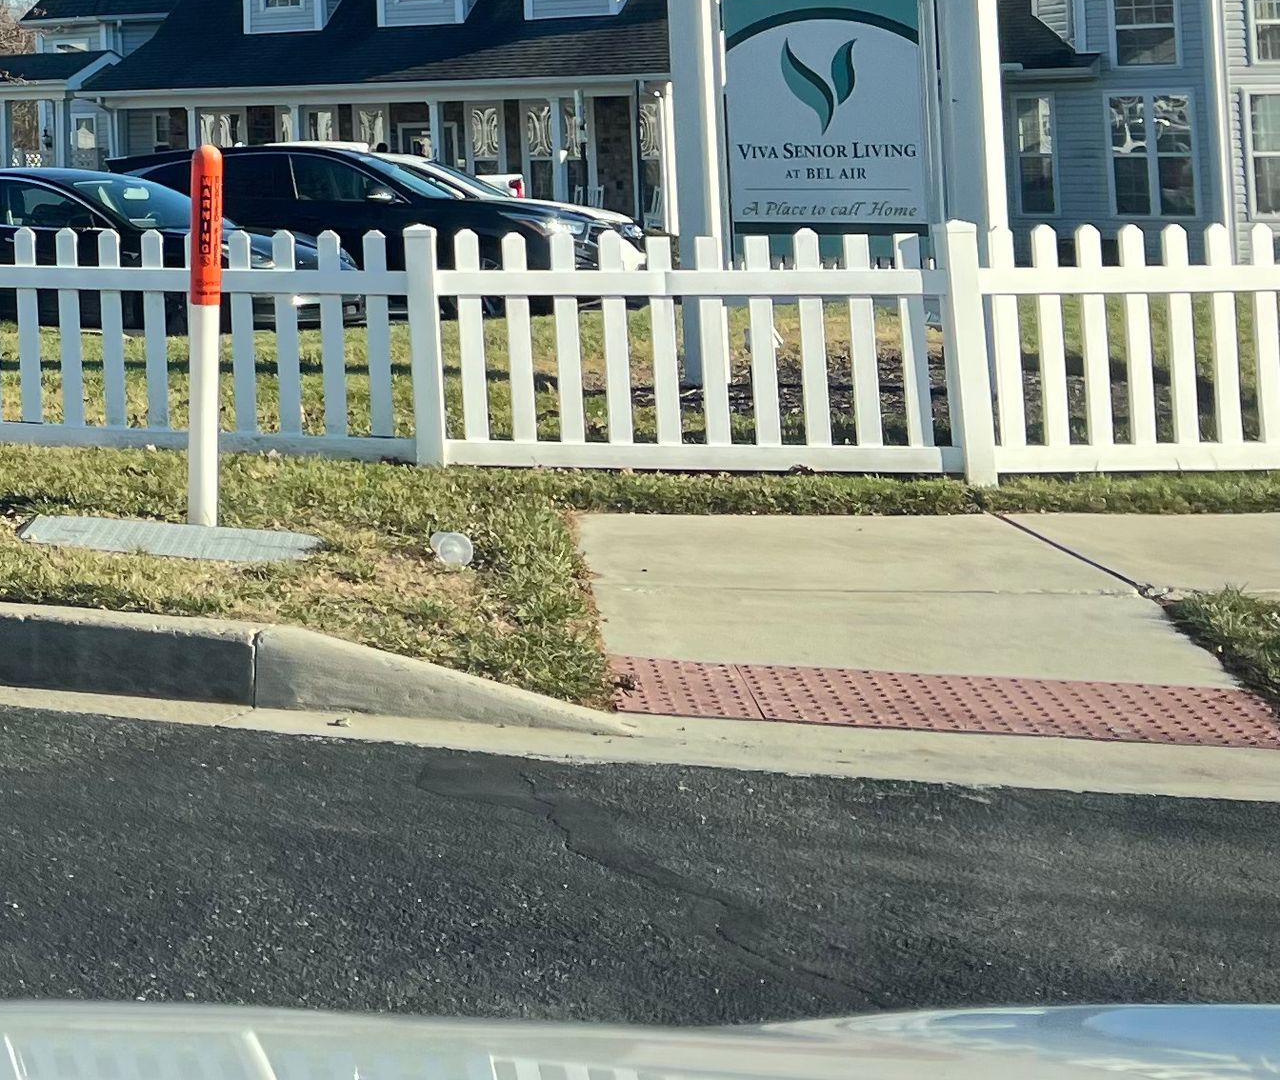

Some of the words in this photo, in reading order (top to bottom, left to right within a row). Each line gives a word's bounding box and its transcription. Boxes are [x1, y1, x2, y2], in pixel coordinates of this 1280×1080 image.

[737, 144, 778, 160] VIVA
[783, 142, 848, 159] SENIOR
[852, 141, 917, 159] LIVING
[785, 169, 800, 179] AT
[806, 167, 835, 180] BEL
[839, 167, 867, 180] AIR
[201, 175, 211, 253] WARNING
[742, 201, 758, 216] A
[765, 201, 807, 216] Place
[811, 205, 826, 216] to
[830, 201, 866, 216] call
[868, 200, 917, 216] Home
